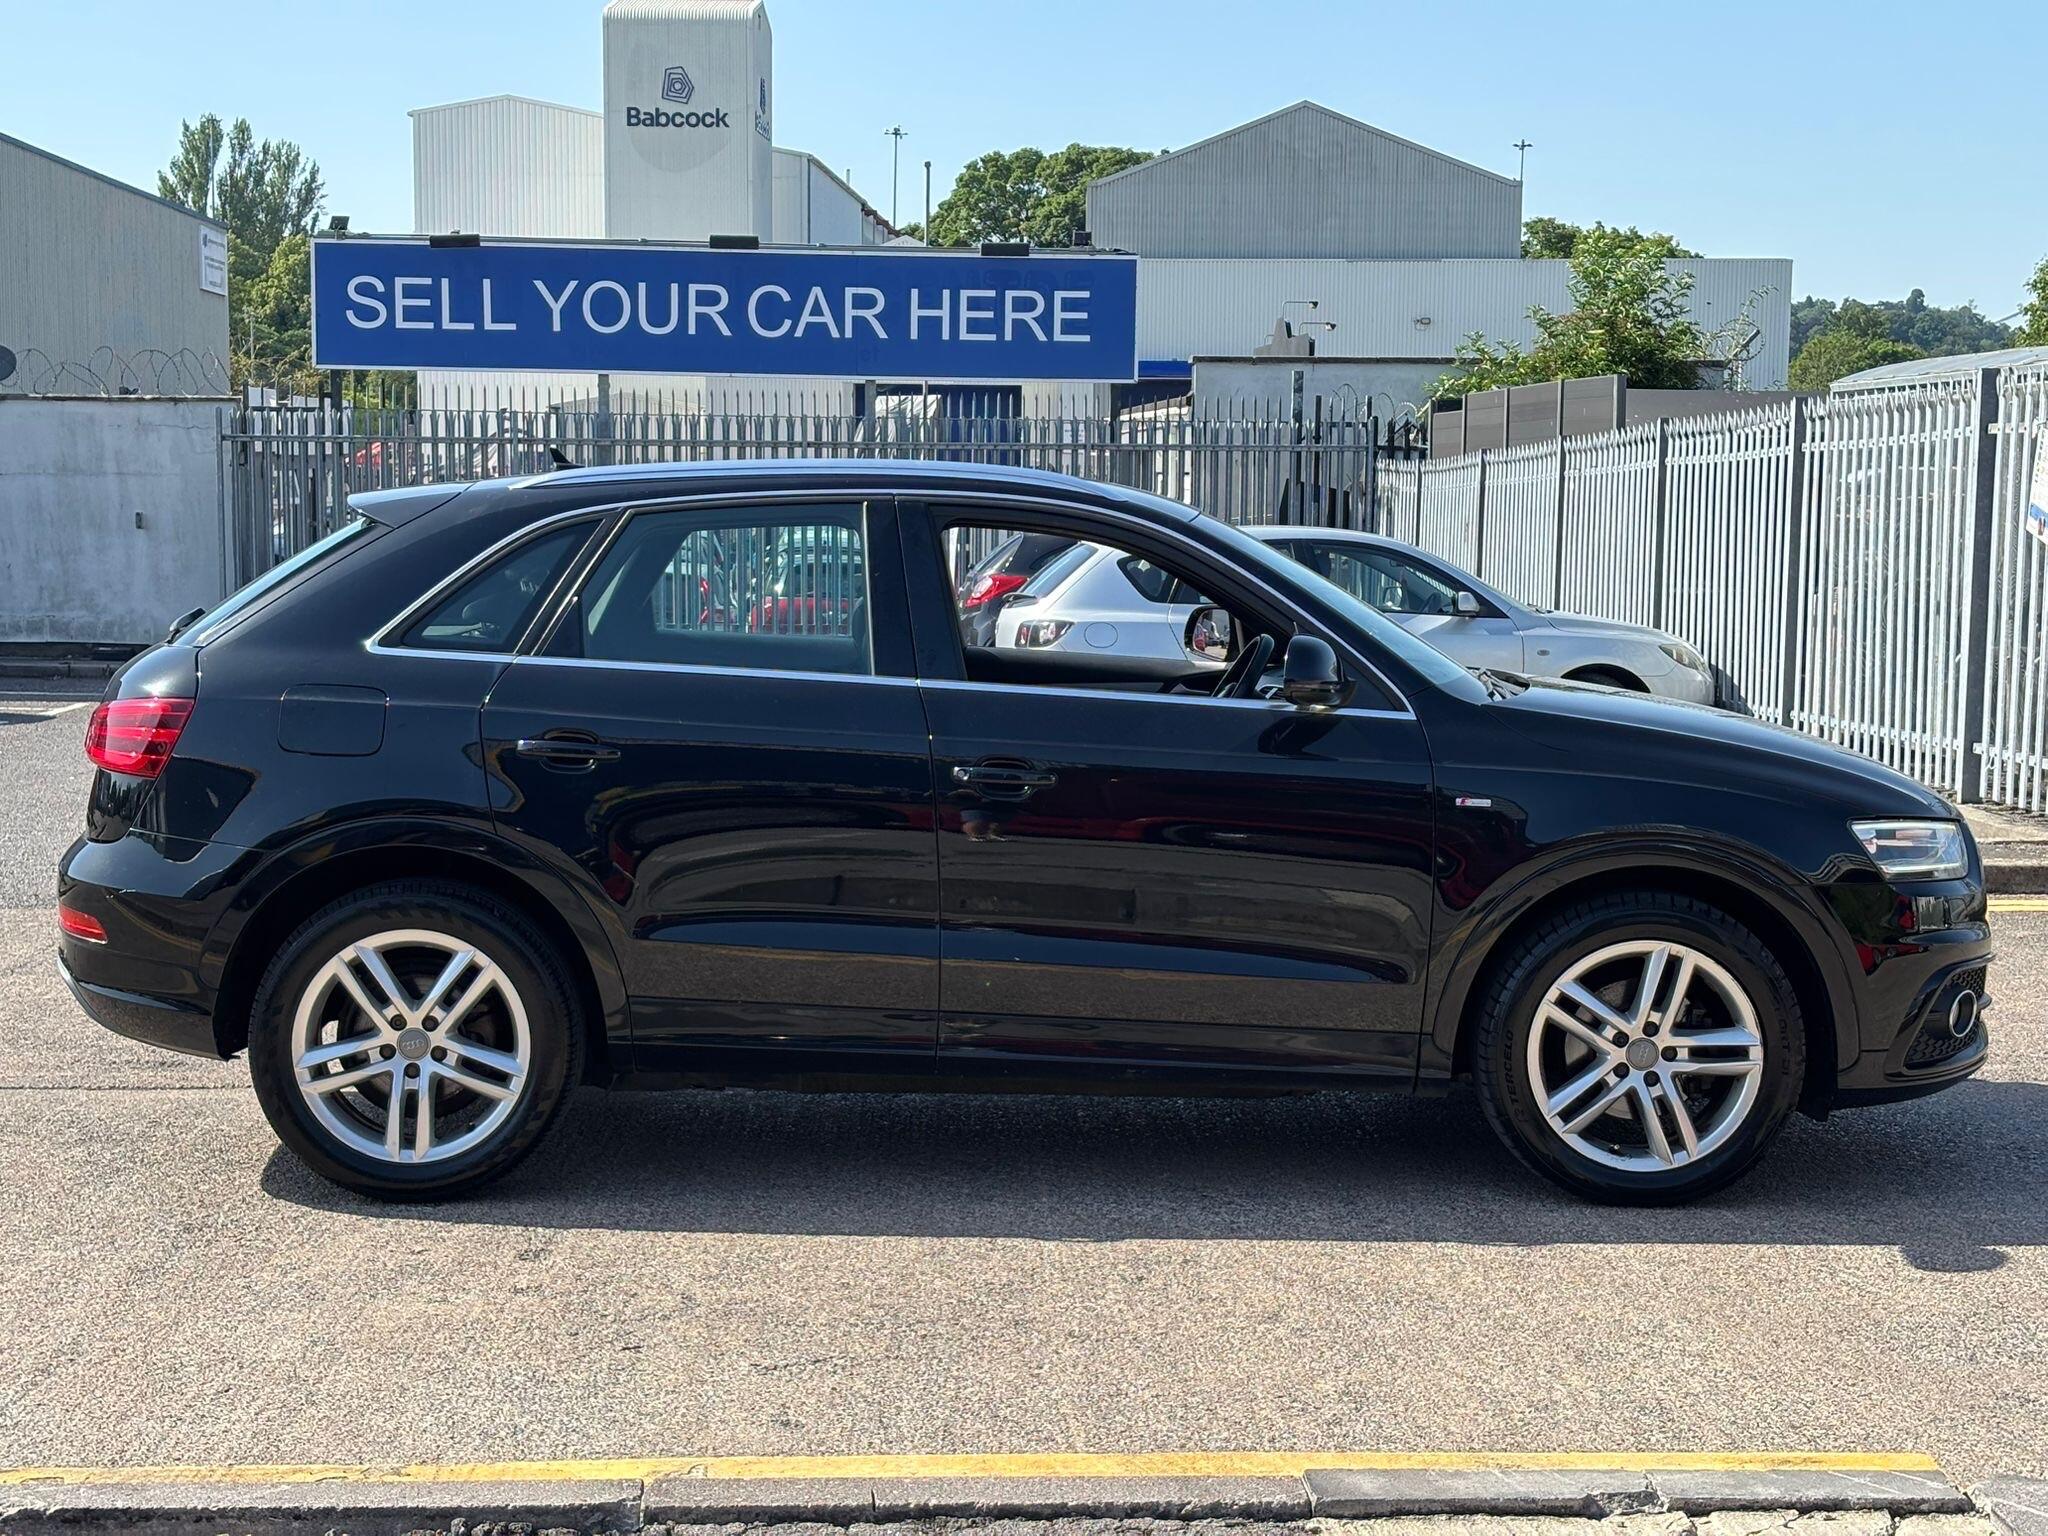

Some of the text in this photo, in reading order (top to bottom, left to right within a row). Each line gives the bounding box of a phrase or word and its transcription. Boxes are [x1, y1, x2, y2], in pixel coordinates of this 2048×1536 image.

[626, 106, 730, 128] Babcock
[345, 275, 1091, 342] SELL YOUR CAR HERE
